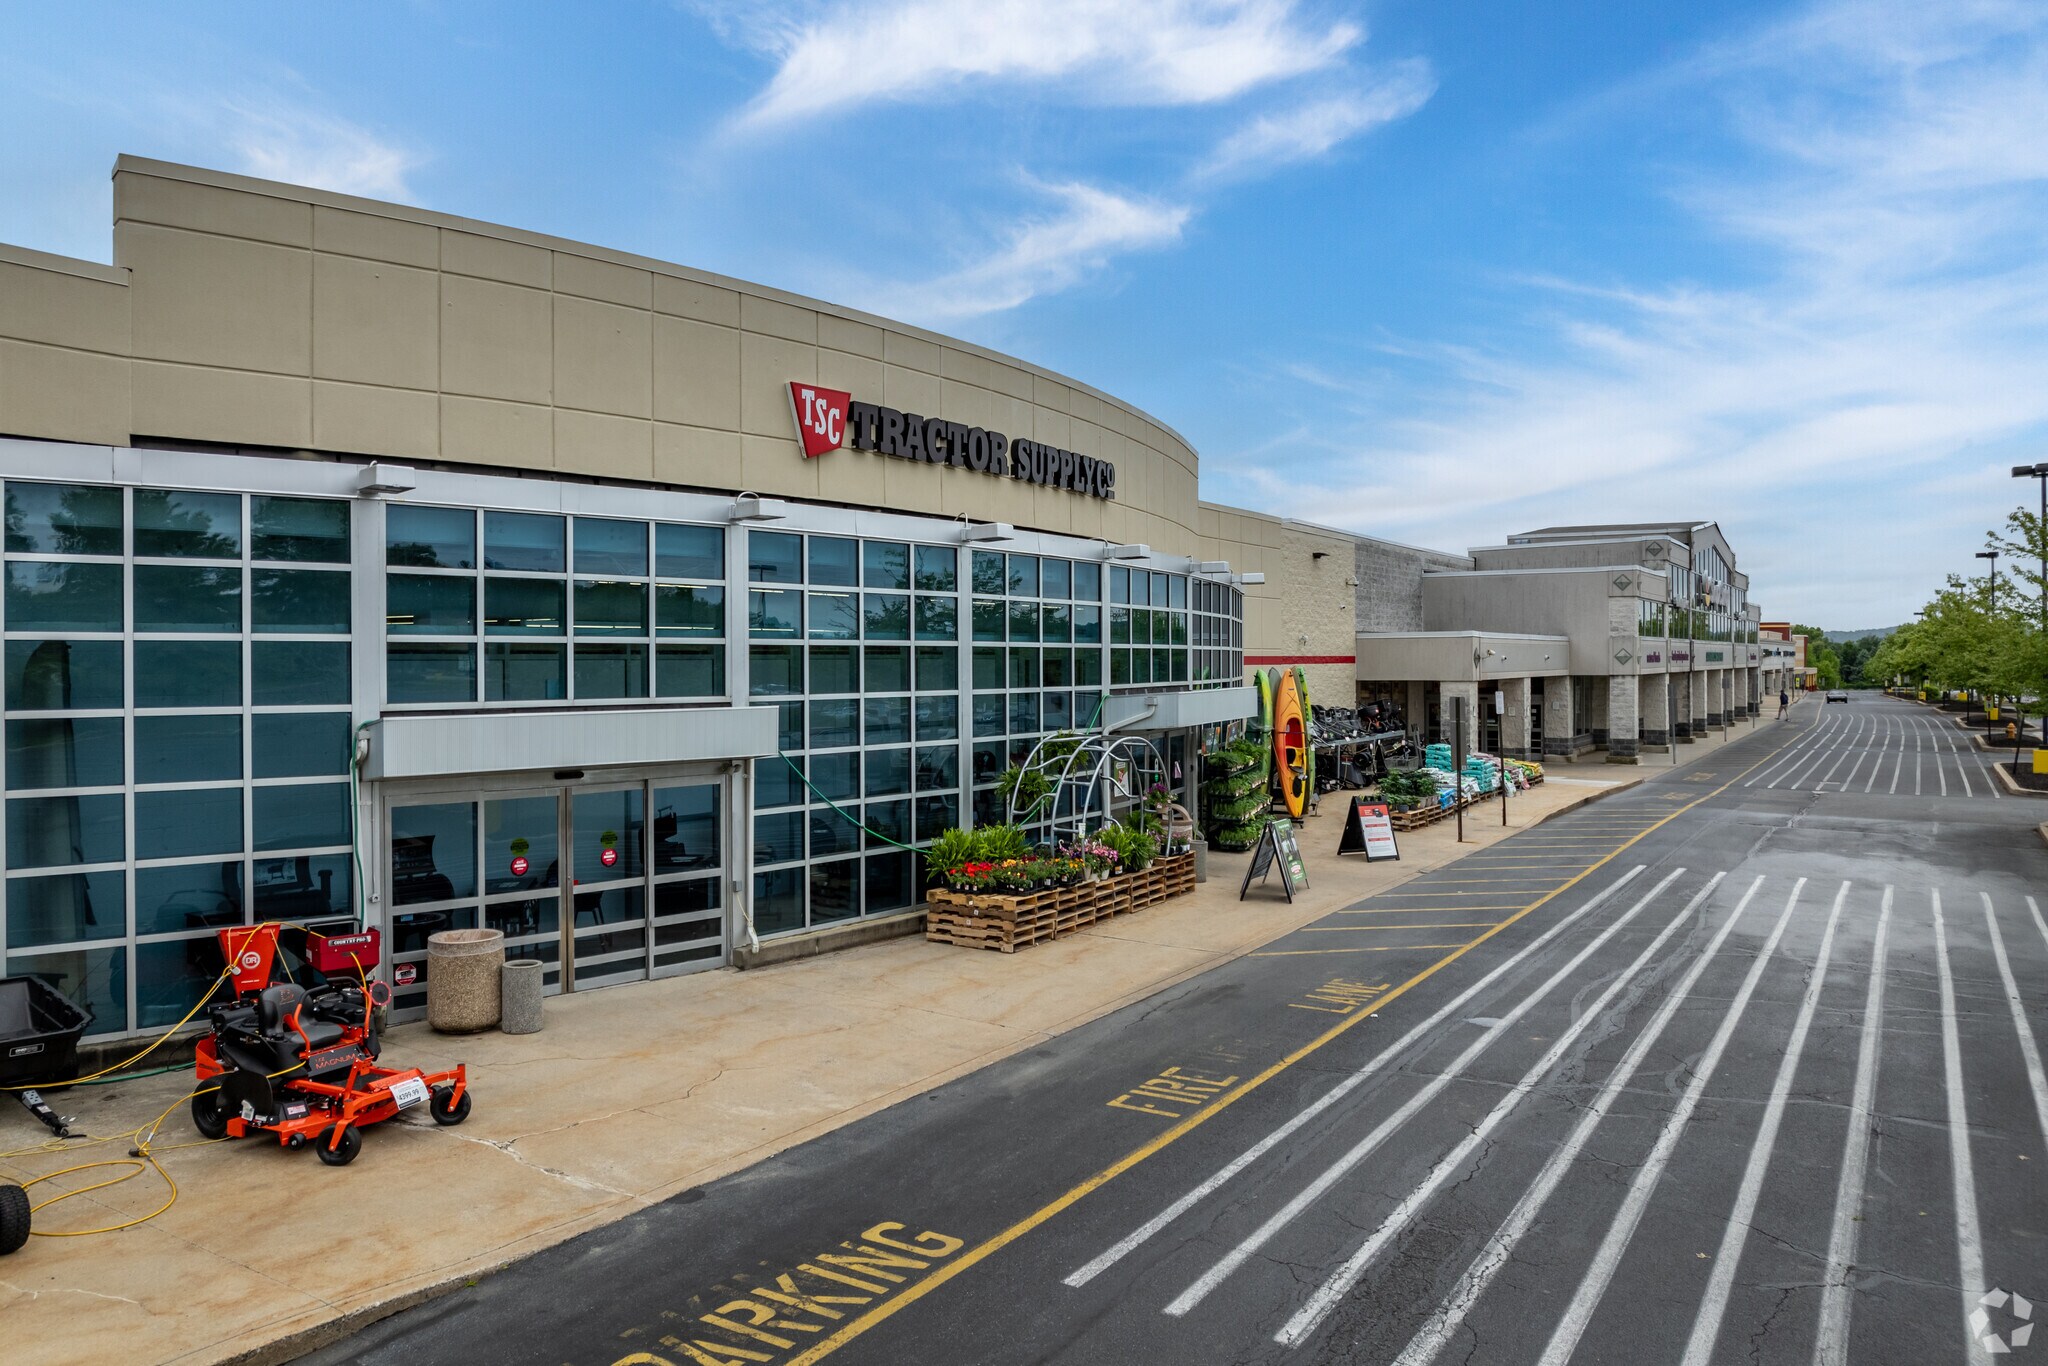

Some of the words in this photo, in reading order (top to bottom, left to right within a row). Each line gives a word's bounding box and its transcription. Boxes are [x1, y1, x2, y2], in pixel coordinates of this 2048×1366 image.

[800, 388, 842, 446] TSC
[848, 401, 1009, 476] TRACTOR
[1010, 437, 1096, 495] SUPPLY
[245, 956, 257, 965] DR
[1287, 977, 1392, 1015] LANE
[315, 1052, 356, 1070] MAGNUM
[1106, 1066, 1241, 1119] FIRE
